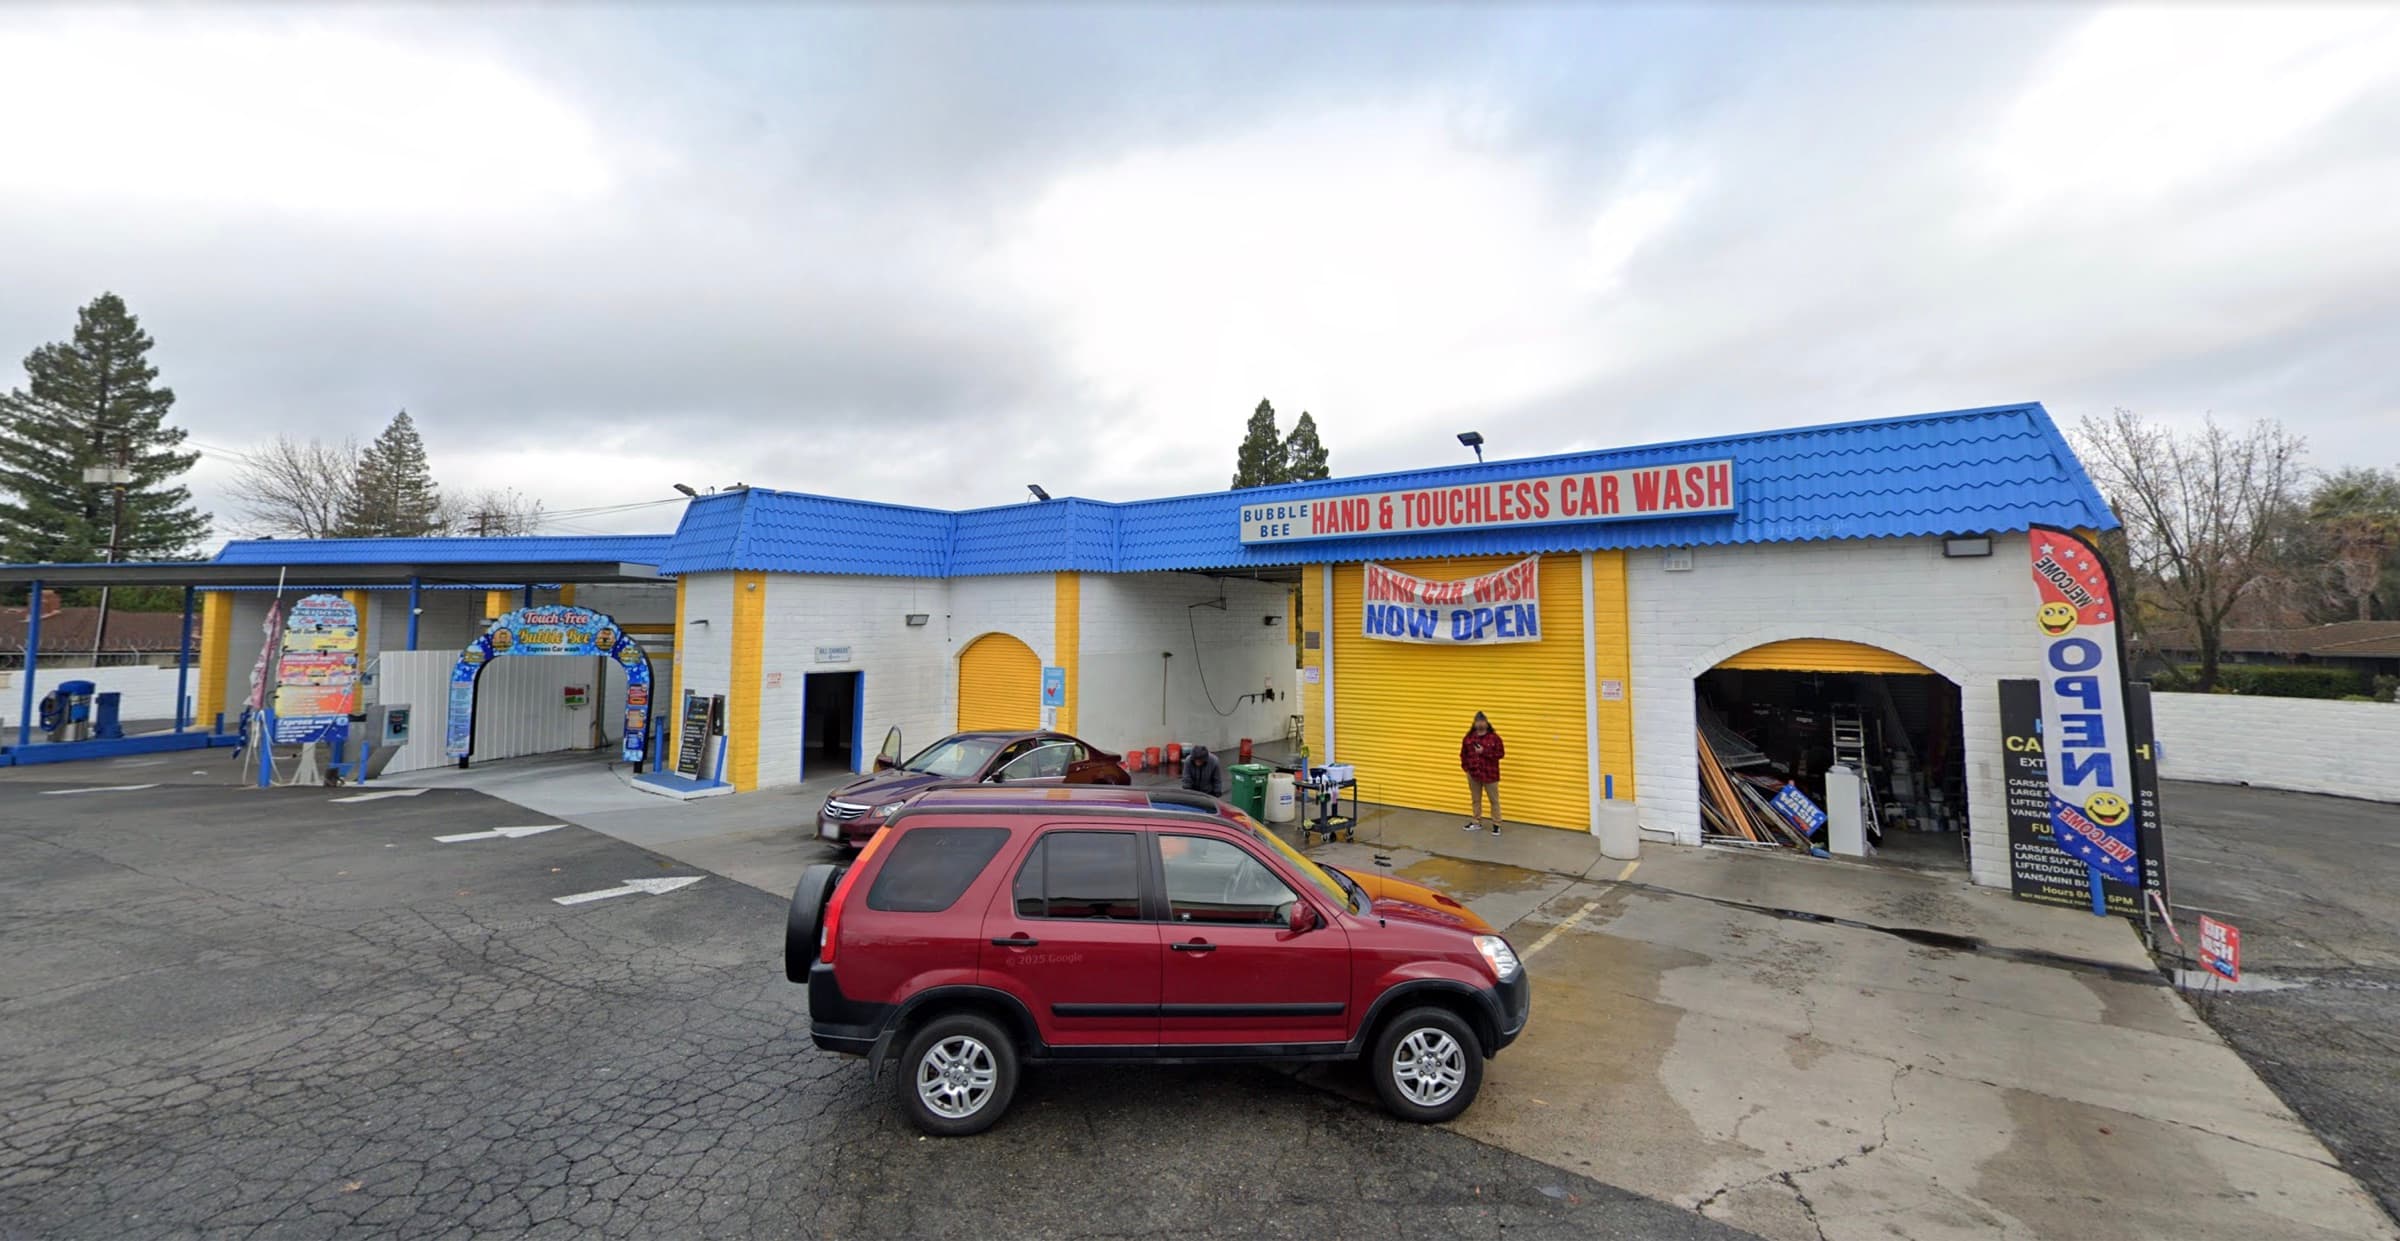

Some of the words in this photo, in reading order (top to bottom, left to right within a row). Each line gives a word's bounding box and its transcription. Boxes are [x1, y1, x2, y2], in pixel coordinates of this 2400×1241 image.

[1312, 498, 1370, 534] HAND
[1379, 496, 1393, 530] &
[1402, 481, 1550, 528] TOUCHLESS
[1560, 475, 1619, 517] CAR
[1632, 464, 1729, 512] WASH
[1243, 504, 1308, 523] BUBBLE
[1260, 523, 1290, 538] BEE
[1367, 566, 1417, 603] HAND
[1422, 581, 1466, 605] CAR
[1473, 560, 1536, 603] WASH
[1366, 604, 1438, 639] NOW
[1451, 604, 1537, 641] OPEN
[519, 629, 563, 644] Bubble
[566, 630, 591, 644] Bee
[2006, 736, 2042, 752] CA
[1779, 791, 1817, 828] WASH
[1790, 790, 1819, 817] CAR
[2015, 852, 2048, 862] LARGE
[2015, 861, 2090, 877] LIFTED/DUALL
[2017, 872, 2072, 885] VANS/MINI
[2042, 885, 2074, 897] Hours
[2076, 891, 2091, 899] 9A
[2108, 895, 2133, 906] 5PM
